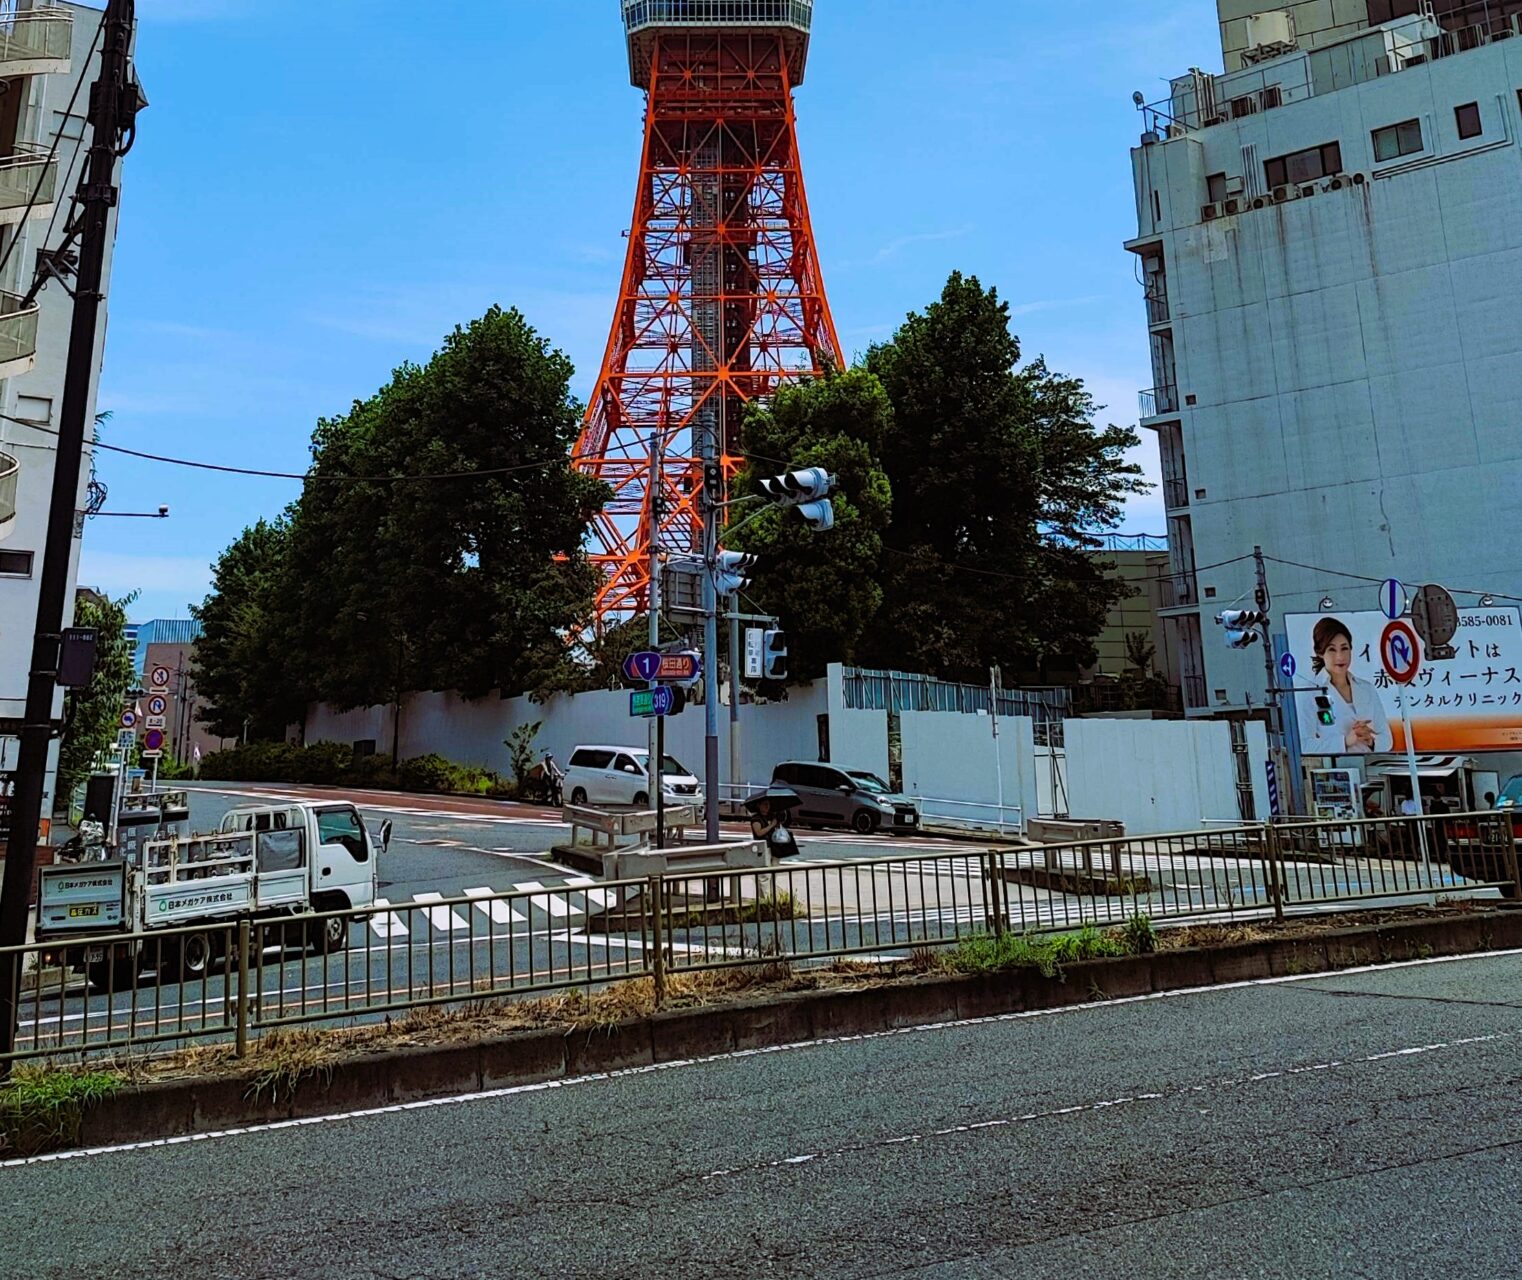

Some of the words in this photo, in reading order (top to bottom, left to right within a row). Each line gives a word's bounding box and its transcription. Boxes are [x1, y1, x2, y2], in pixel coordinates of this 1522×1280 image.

[642, 657, 650, 674] 1
[654, 692, 666, 709] 319
[64, 879, 113, 889] 日本メガケア株式会社
[168, 892, 233, 910] 日本メガケア株式会社
